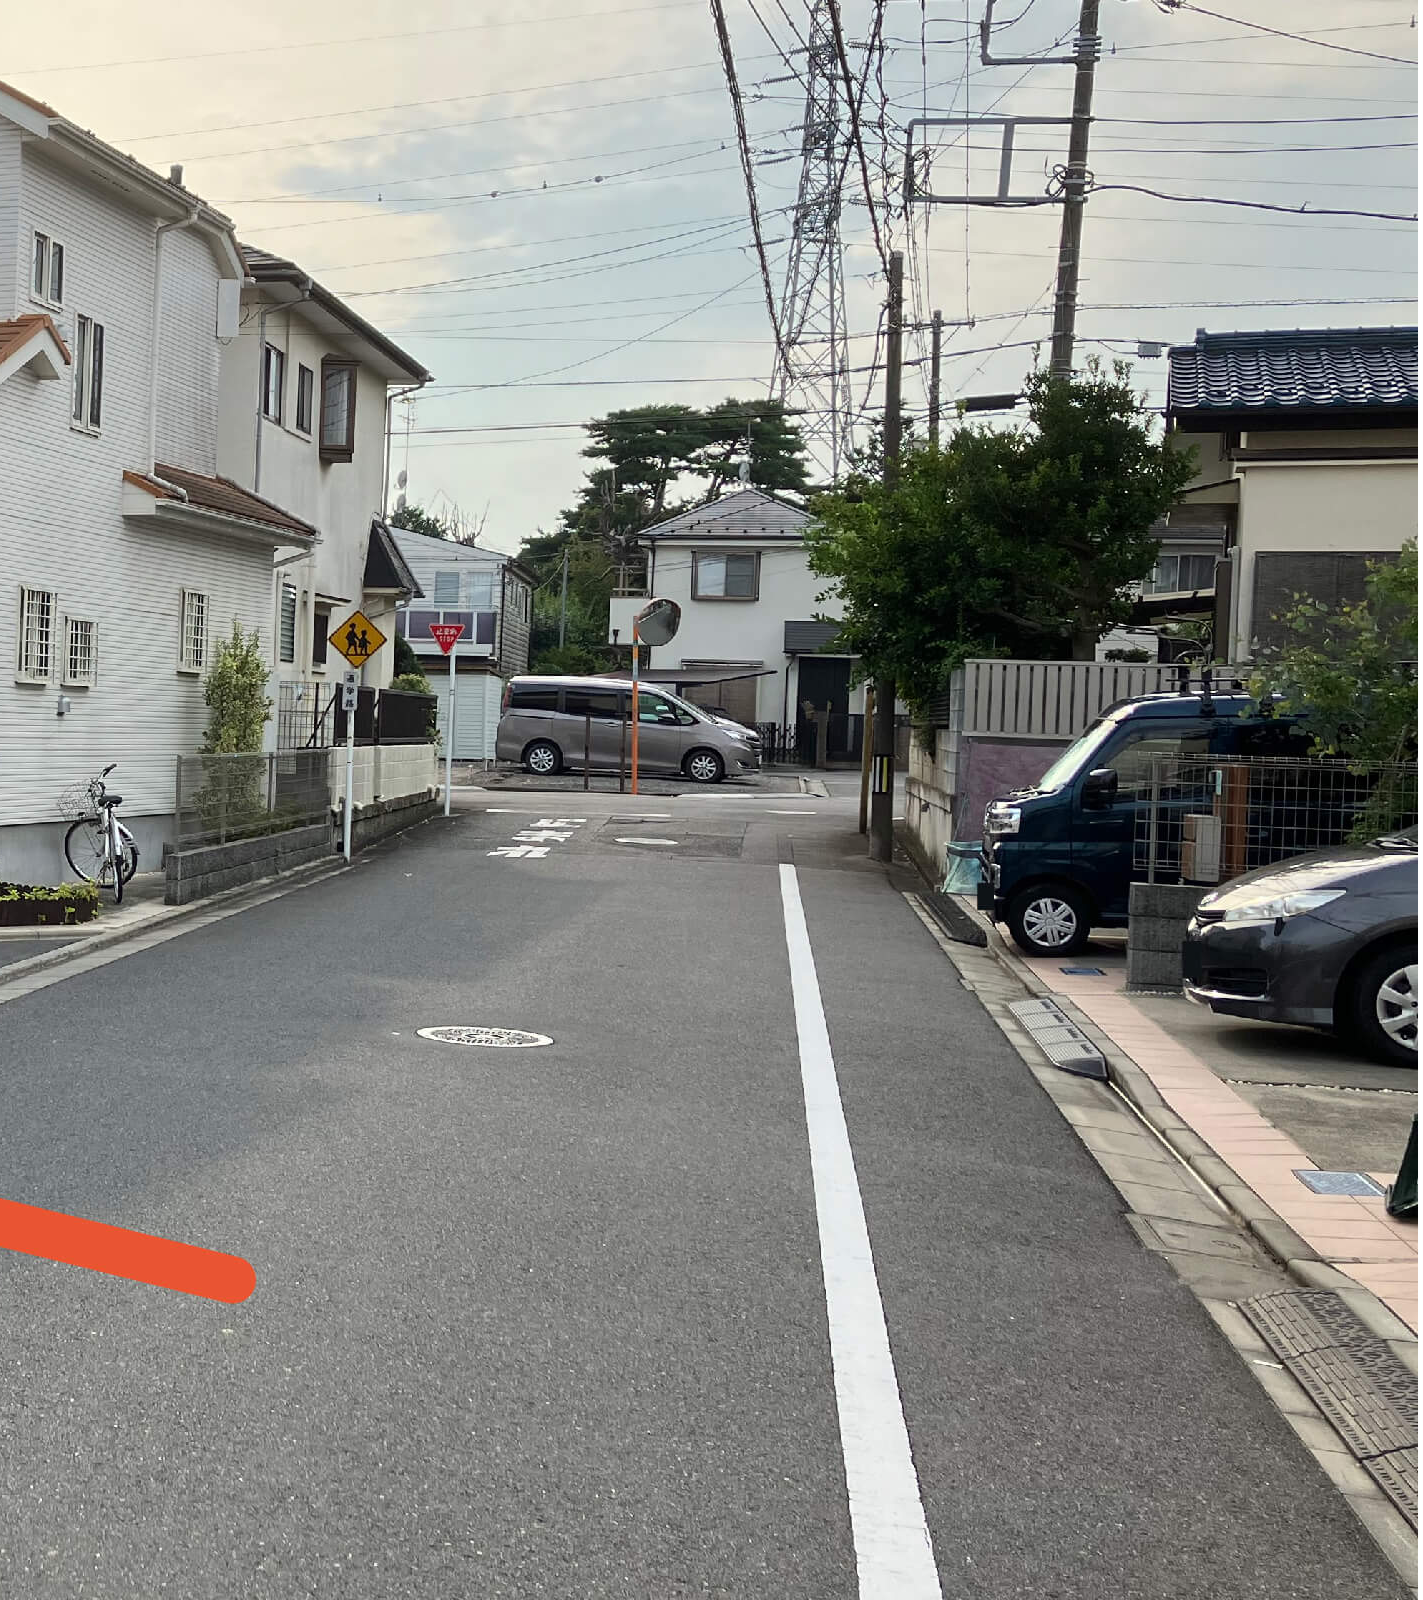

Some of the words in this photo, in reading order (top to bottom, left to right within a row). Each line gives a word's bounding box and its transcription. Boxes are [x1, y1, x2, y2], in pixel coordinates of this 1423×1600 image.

[435, 627, 458, 635] 止まれ
[486, 818, 587, 858] 止まれ
